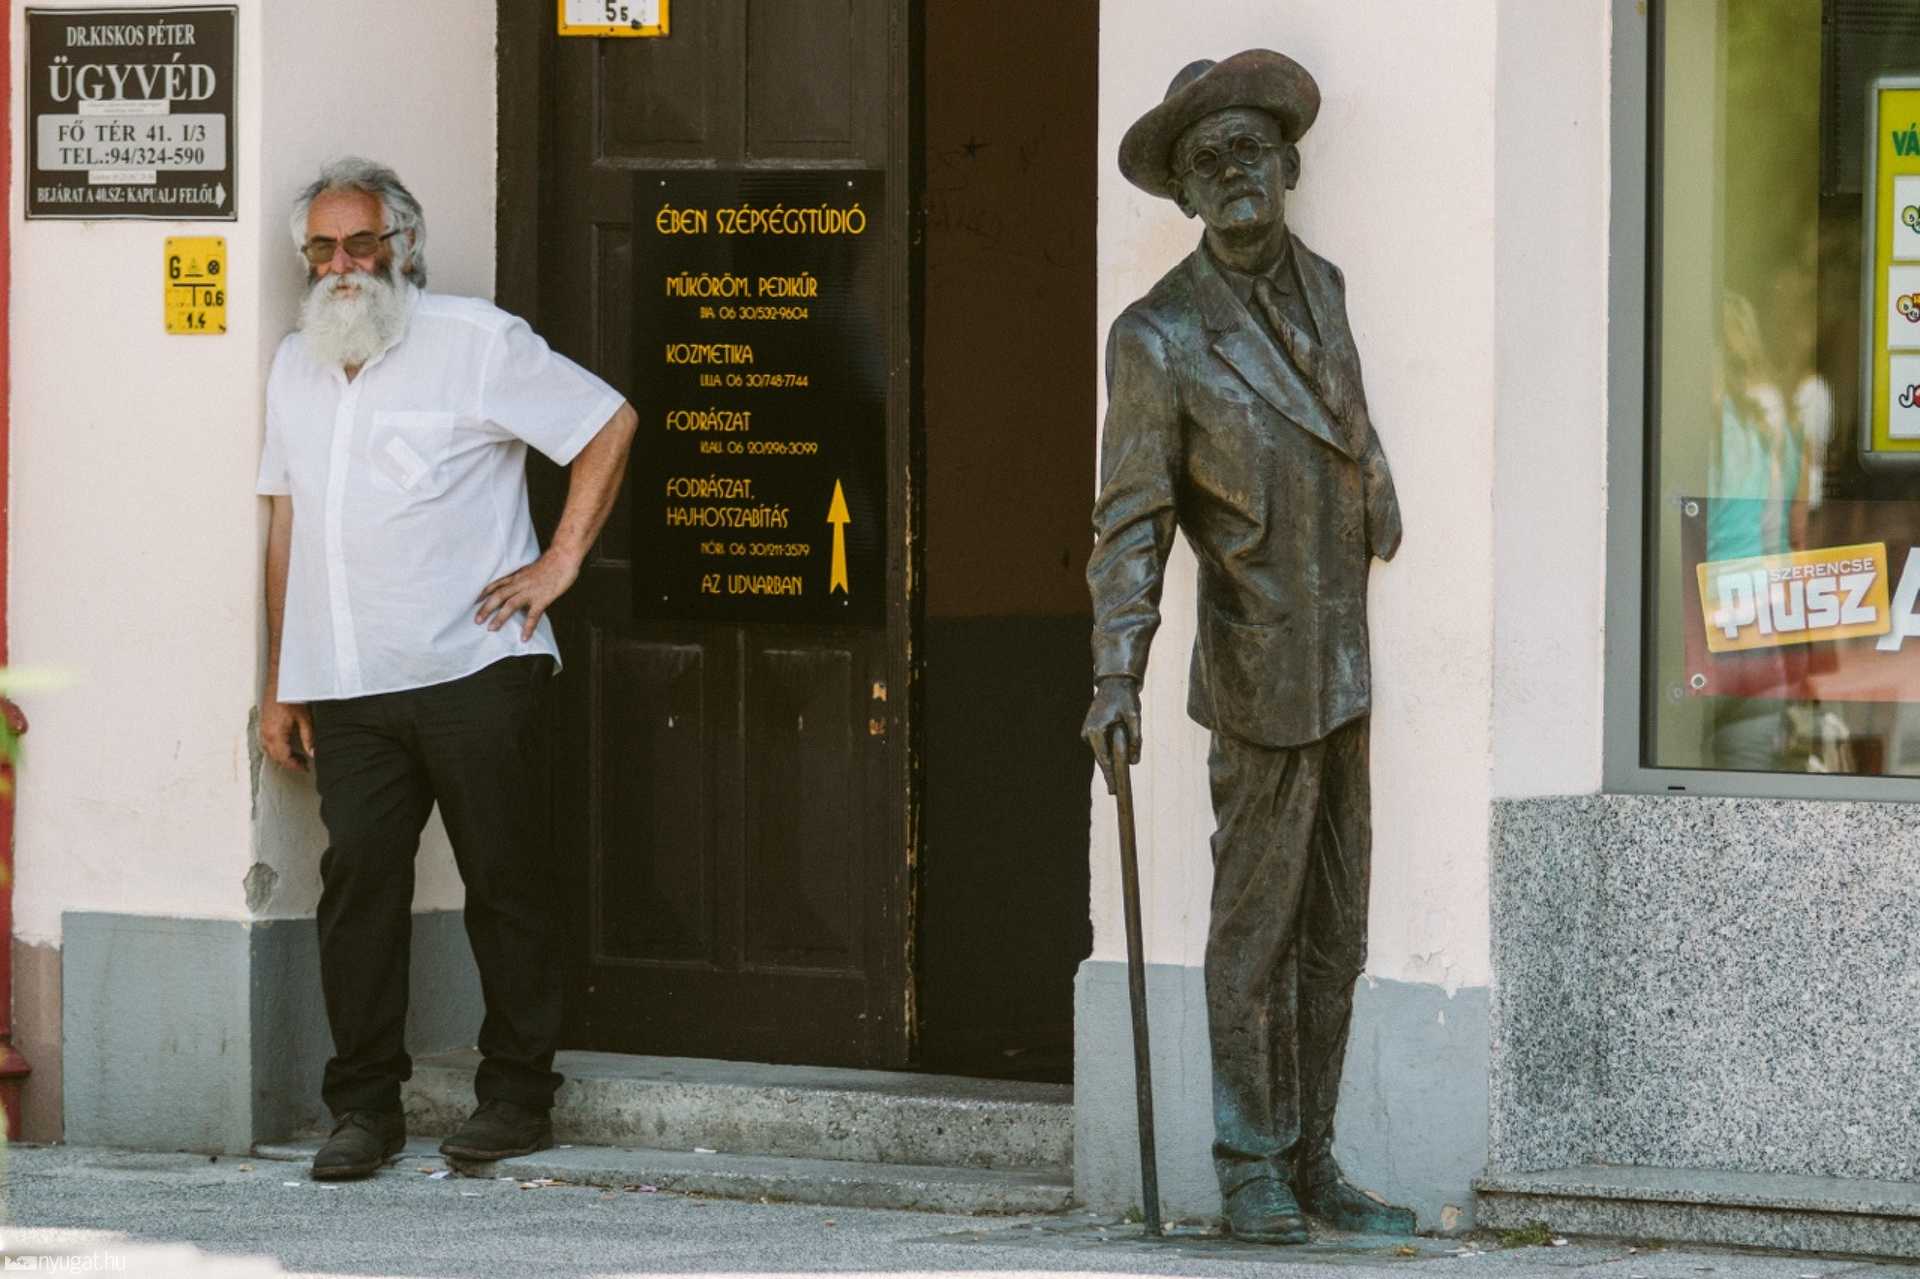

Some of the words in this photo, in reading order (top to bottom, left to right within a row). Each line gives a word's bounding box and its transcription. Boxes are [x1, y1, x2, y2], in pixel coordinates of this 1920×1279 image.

[147, 19, 196, 45] PÉTER
[48, 53, 216, 102] ÜGYVÉD
[58, 120, 85, 142] FŐ
[96, 120, 136, 142] TÉR
[146, 125, 172, 142] 41.
[37, 183, 84, 203] BEJÁRAT
[87, 188, 94, 203] A
[656, 204, 708, 234] ÉBEN
[716, 203, 866, 235] SZÉPSÉGSTÚDIÓ
[719, 306, 736, 320] 06
[666, 344, 753, 364] KOZMETIKA
[726, 374, 743, 387] 06
[666, 408, 752, 431] FODRÁSZAT
[727, 441, 744, 454] 06
[666, 504, 790, 528] HAJHOSSZABÍTÁS
[729, 542, 746, 556] 06
[1771, 557, 1876, 581] SZERENCSE
[701, 574, 720, 593] AZ
[728, 575, 802, 596] UDVARBAN
